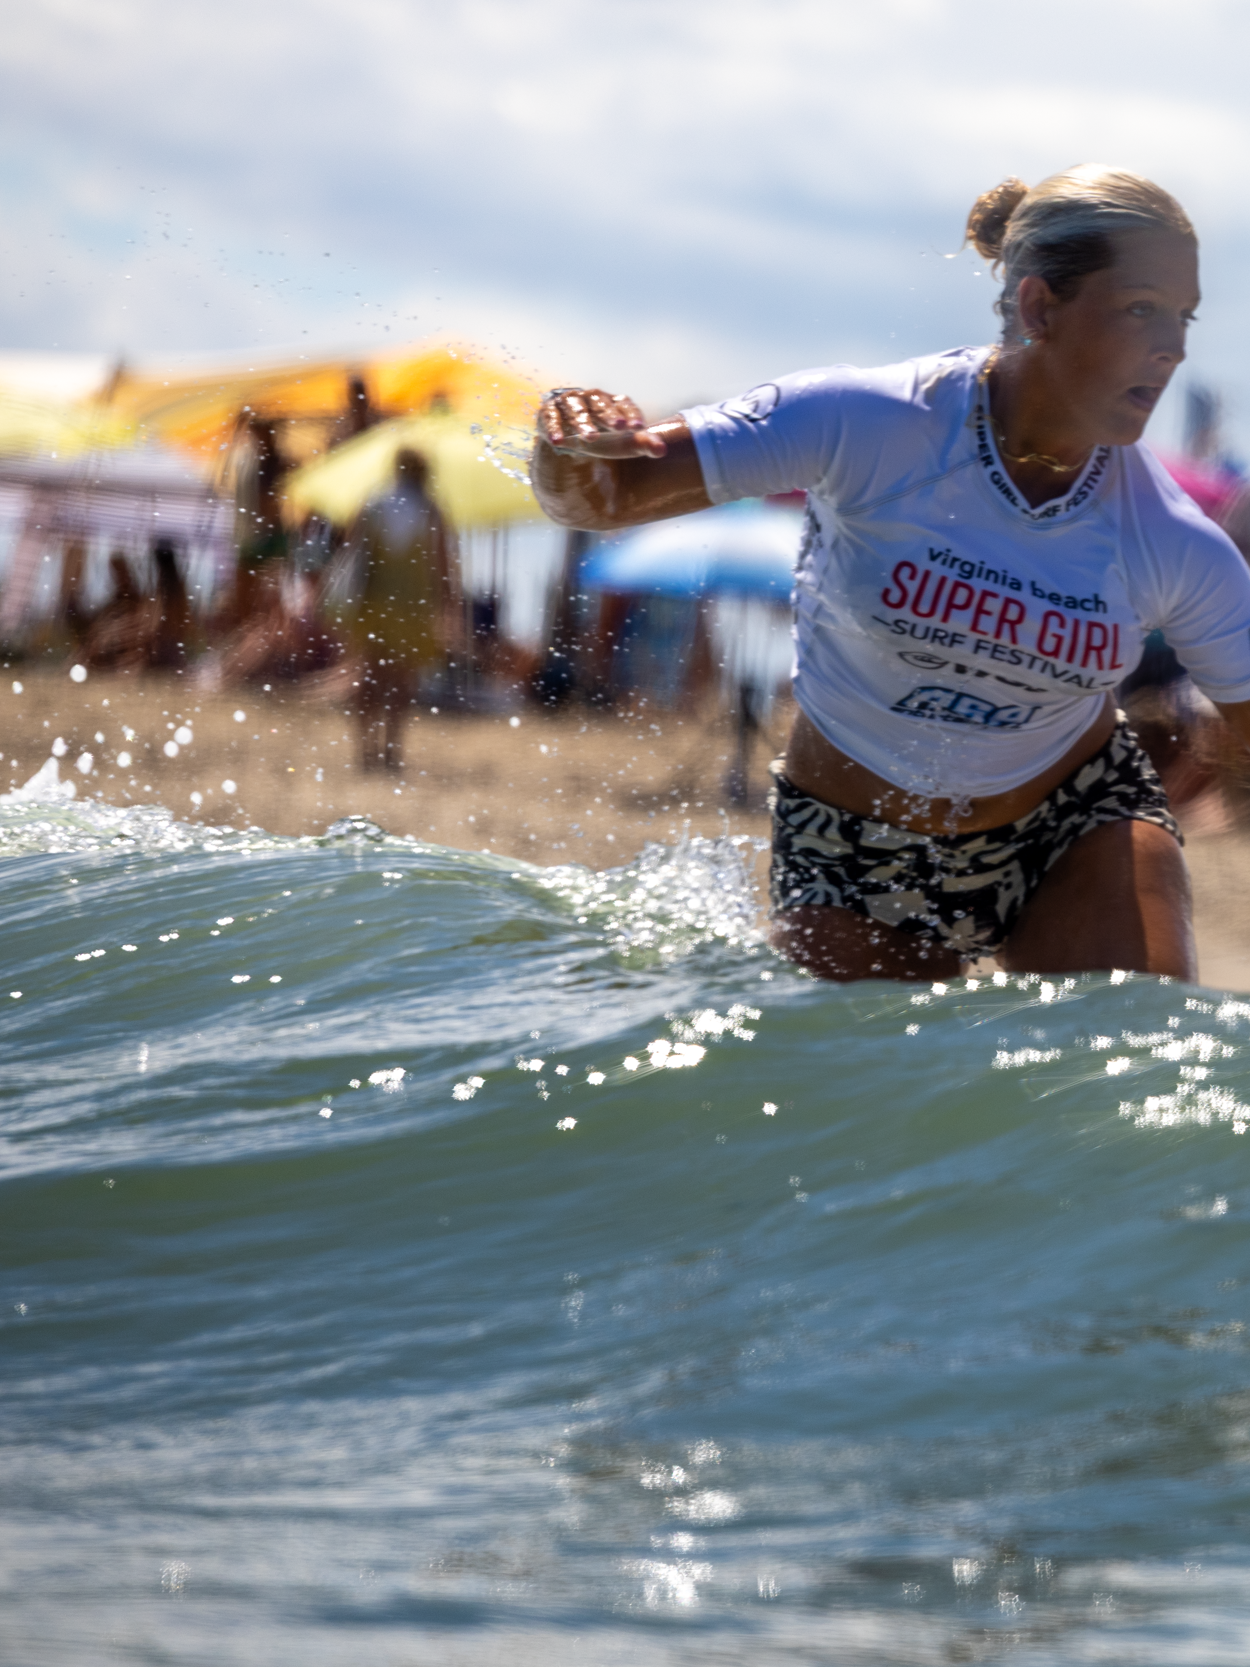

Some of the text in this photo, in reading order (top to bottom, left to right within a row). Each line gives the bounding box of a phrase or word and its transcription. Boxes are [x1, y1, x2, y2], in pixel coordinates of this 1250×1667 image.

[989, 470, 1020, 508] GIRL
[927, 547, 1108, 614] virginia beach
[881, 560, 1124, 671] SUPER GIRL
[888, 618, 967, 648] SURF
[973, 638, 1099, 690] FESTIVAL
